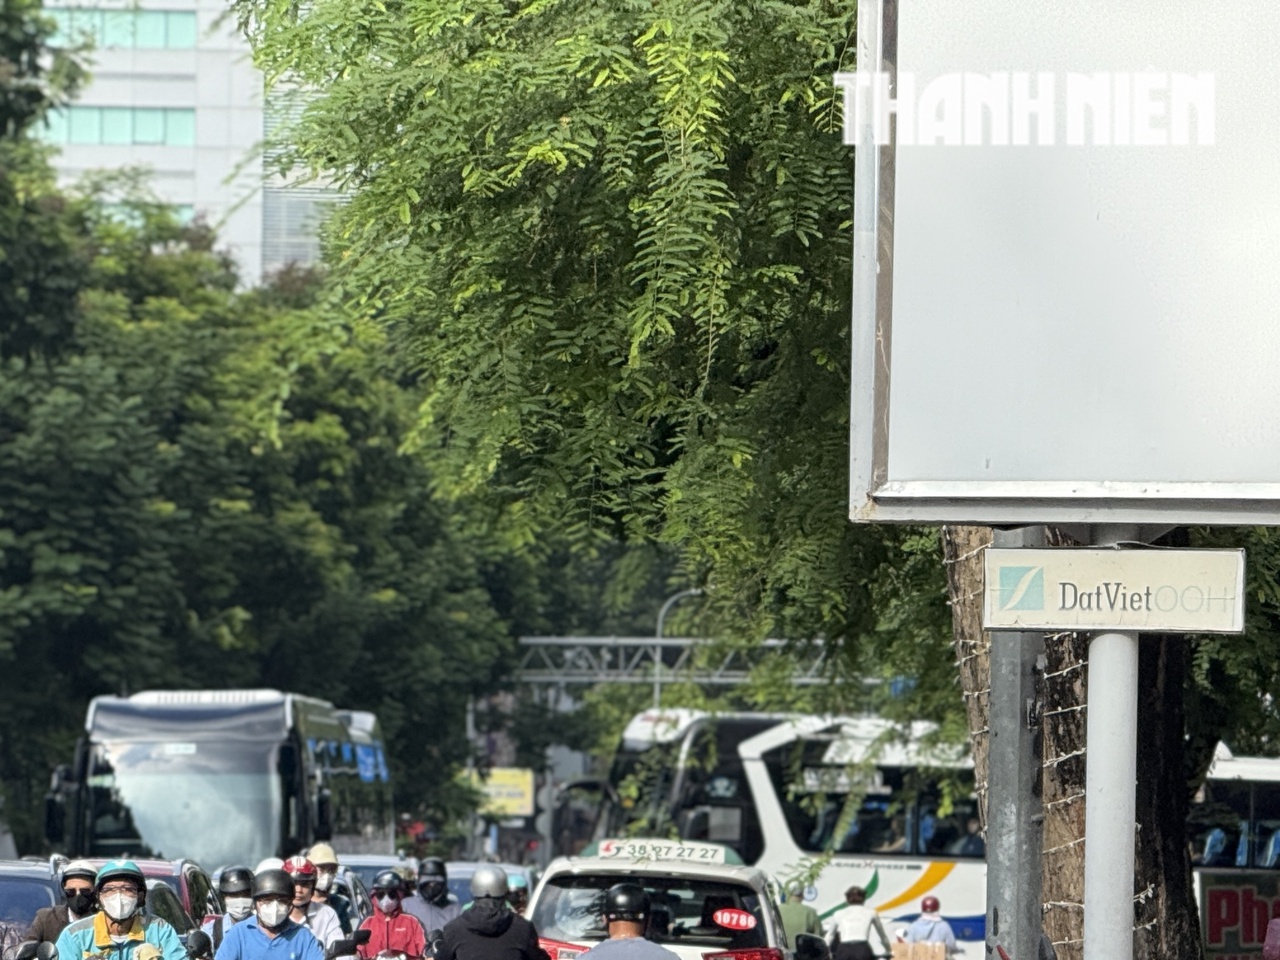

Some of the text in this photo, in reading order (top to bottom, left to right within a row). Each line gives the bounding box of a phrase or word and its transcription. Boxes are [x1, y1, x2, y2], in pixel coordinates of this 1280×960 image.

[627, 844, 647, 856] 38
[675, 846, 695, 859] 27
[699, 847, 719, 860] 27
